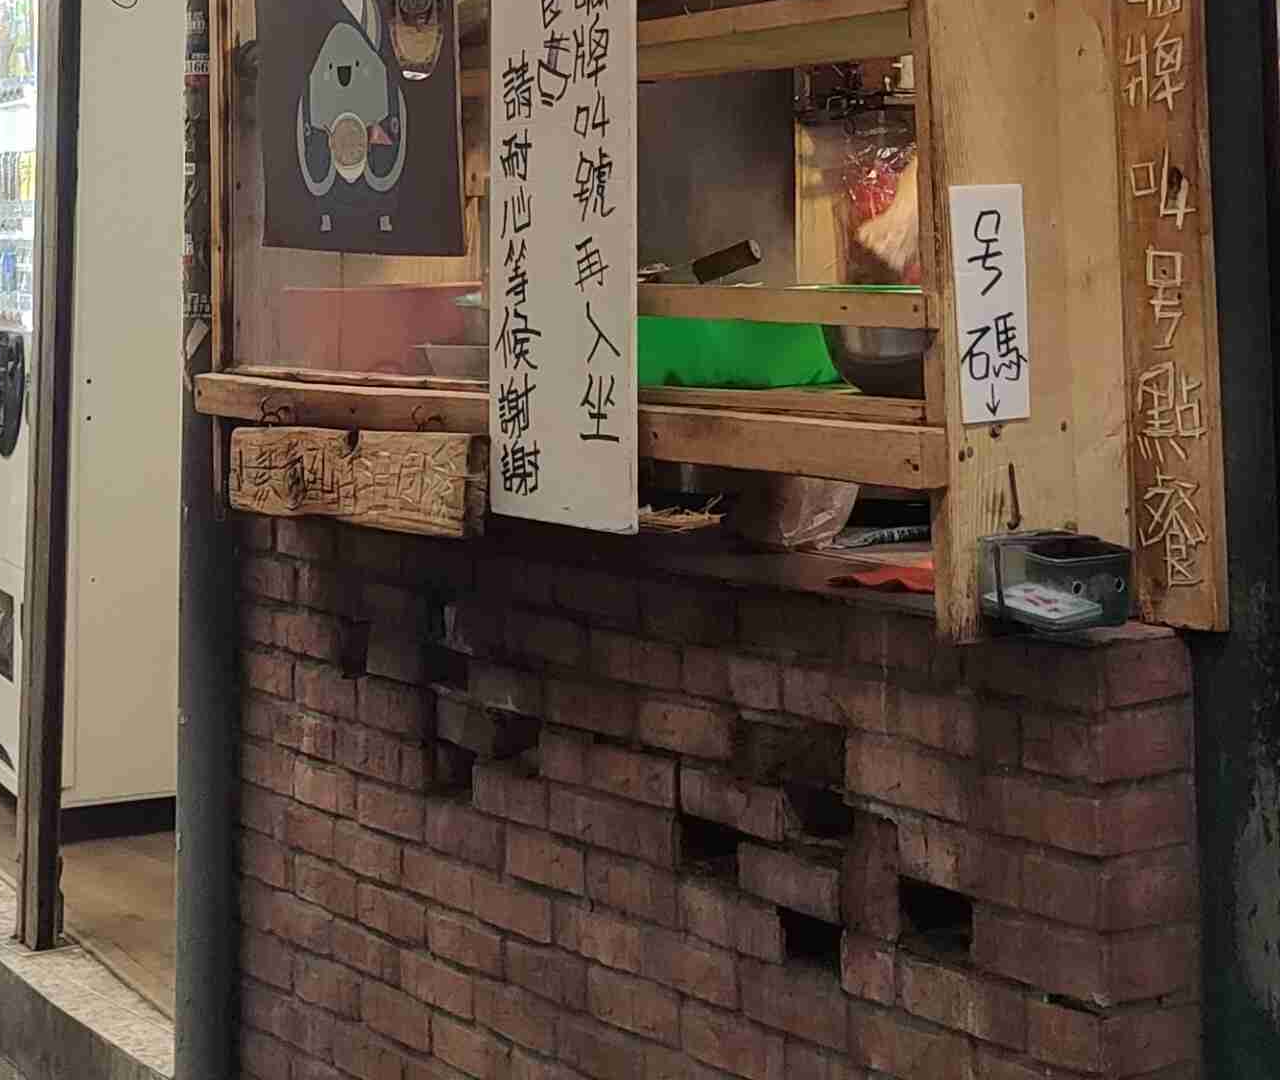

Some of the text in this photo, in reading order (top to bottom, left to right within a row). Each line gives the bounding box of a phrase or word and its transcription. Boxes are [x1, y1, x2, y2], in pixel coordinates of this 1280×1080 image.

[494, 49, 542, 497] 請耐心等候謝謝
